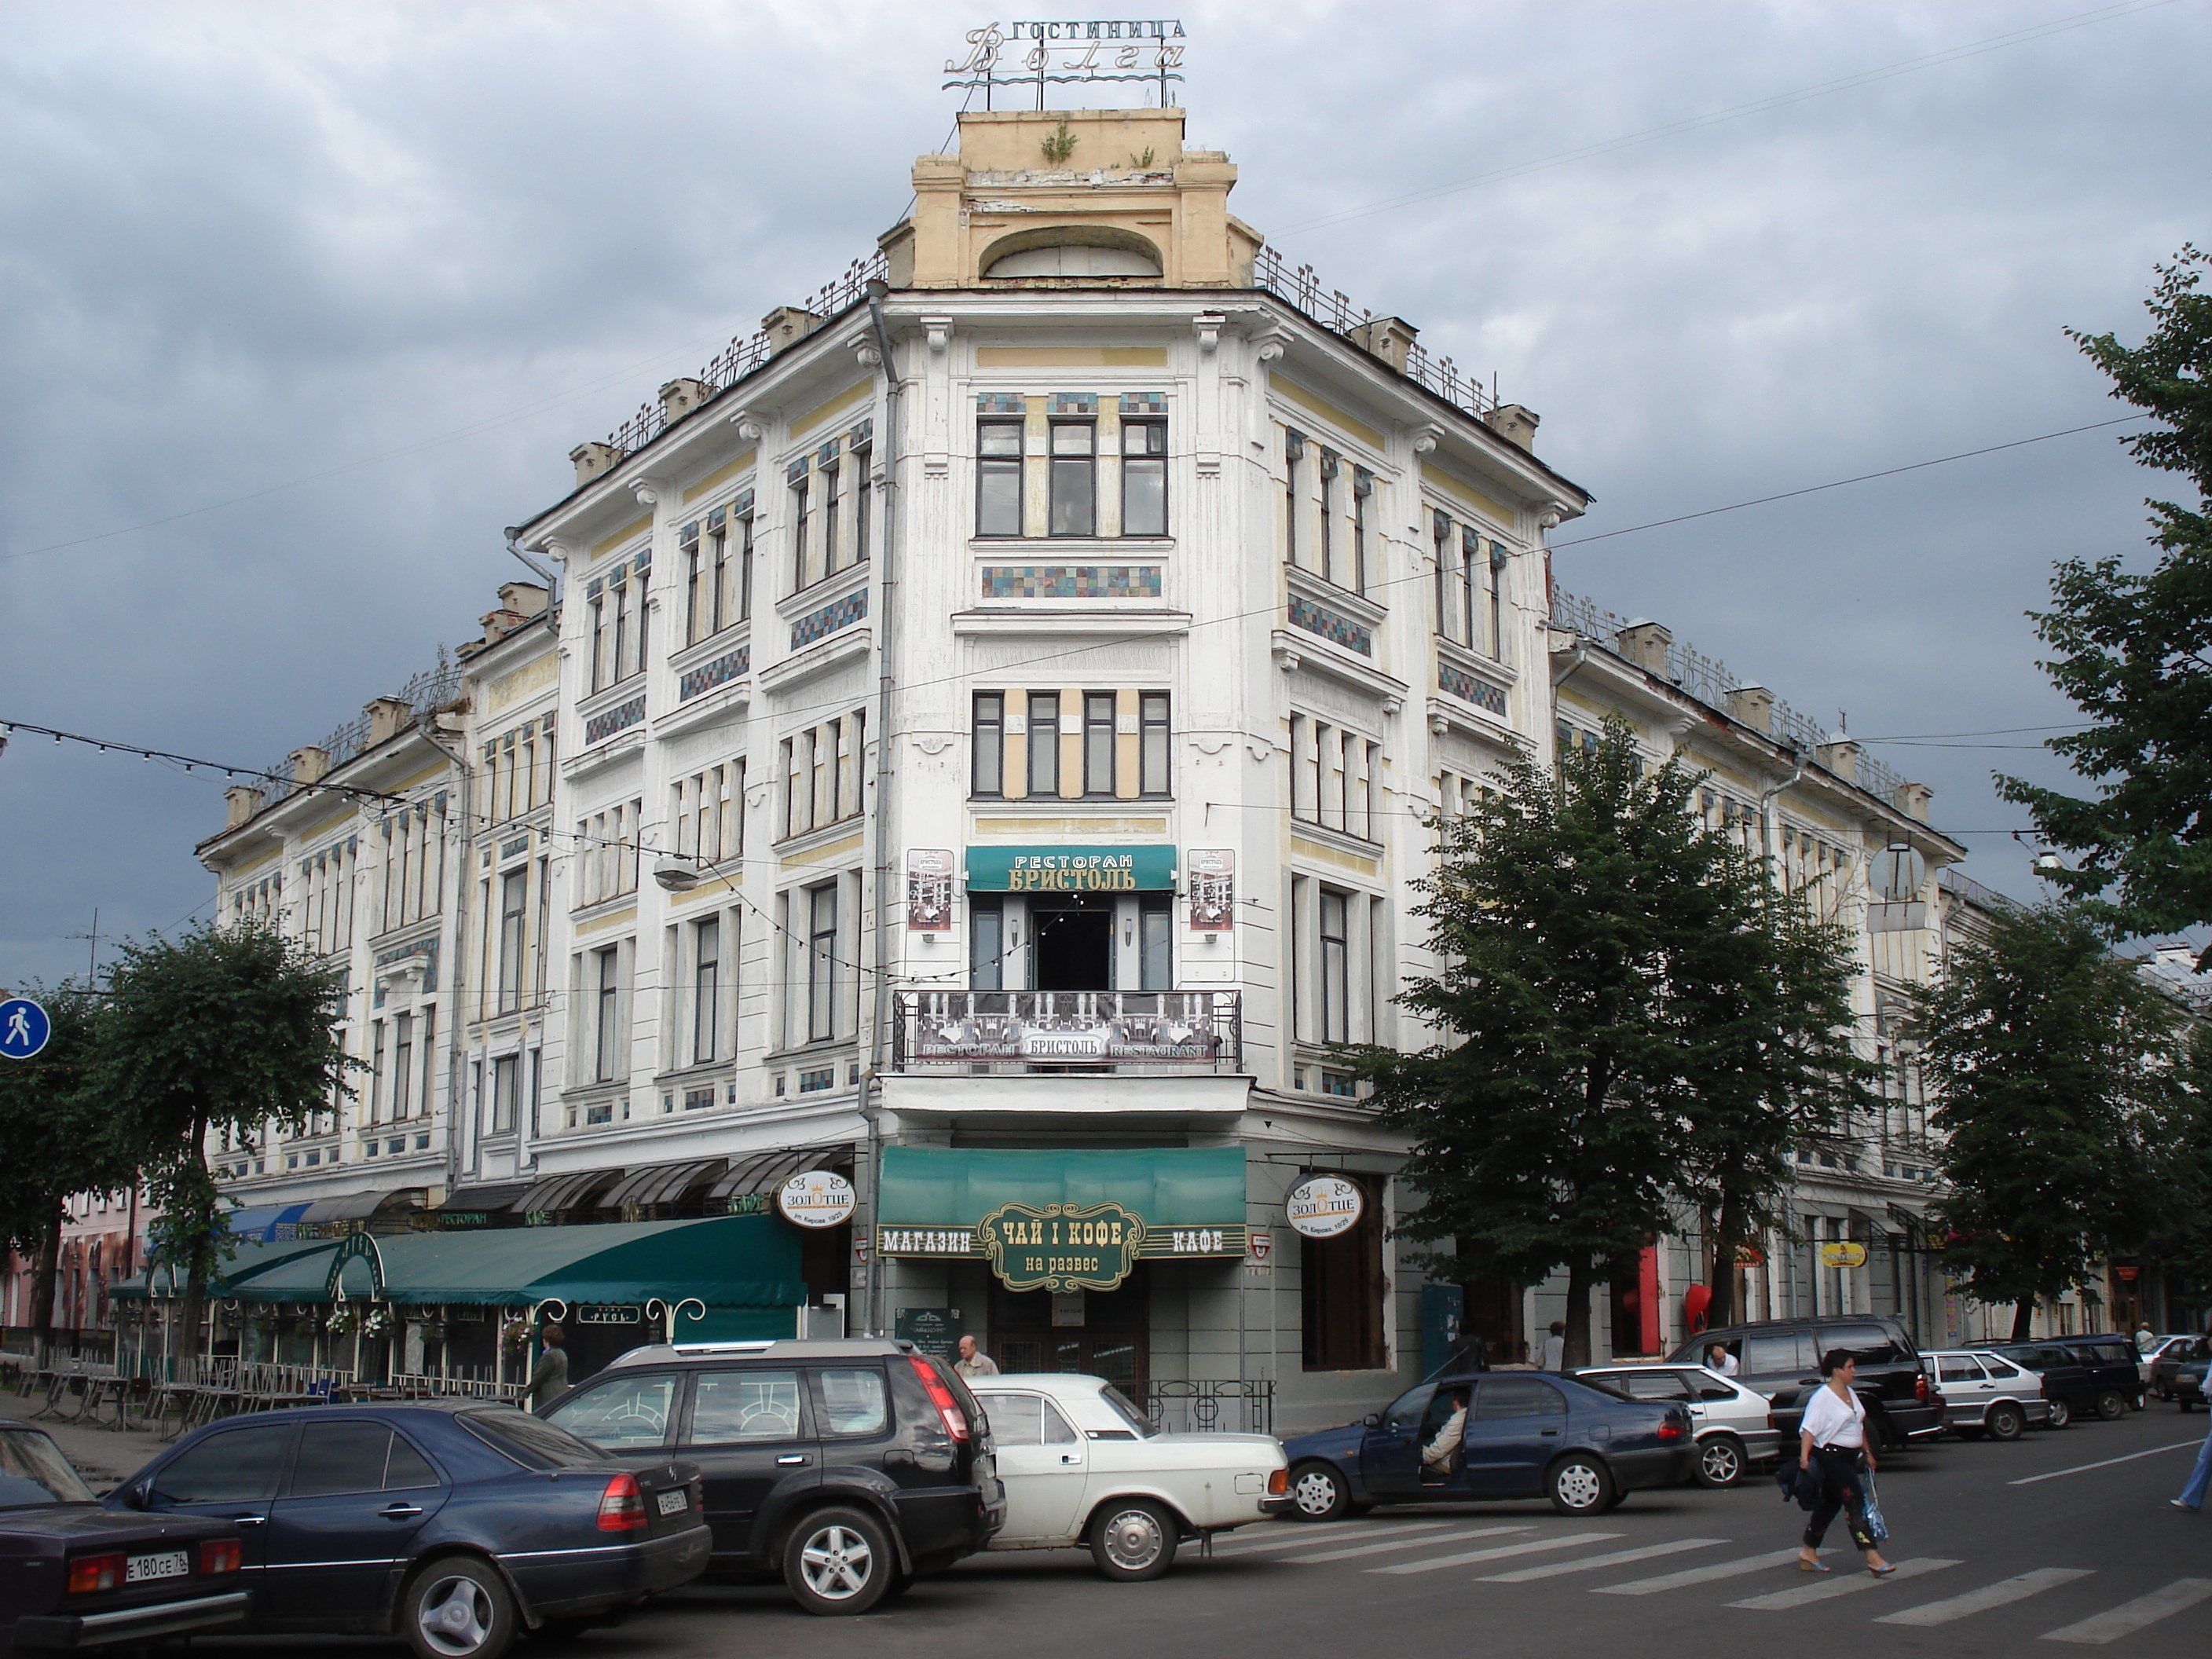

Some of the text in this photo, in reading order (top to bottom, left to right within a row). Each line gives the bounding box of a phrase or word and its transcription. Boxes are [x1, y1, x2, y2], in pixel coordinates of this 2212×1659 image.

[1013, 20, 1185, 38] ГОСТИНИЦА
[1014, 855, 1133, 869] РЕСТОРАН
[1008, 868, 1136, 890] БРИСТОЛЬ
[922, 1043, 1016, 1057] РЕСТОРАН
[1030, 1040, 1097, 1054] БРИСТОЛЬ
[1111, 1044, 1208, 1057] RESTAURANT
[787, 1192, 849, 1205] ЗОЛОТЦЕ
[1292, 1199, 1355, 1215] ЗОЛОТЦЕ
[1002, 1219, 1043, 1245] ЧАЙ
[1068, 1219, 1122, 1247] КОФЕ
[1173, 1228, 1223, 1254] КАФЕ
[883, 1230, 971, 1253] МАГАЗИН
[1025, 1257, 1098, 1274] на развес
